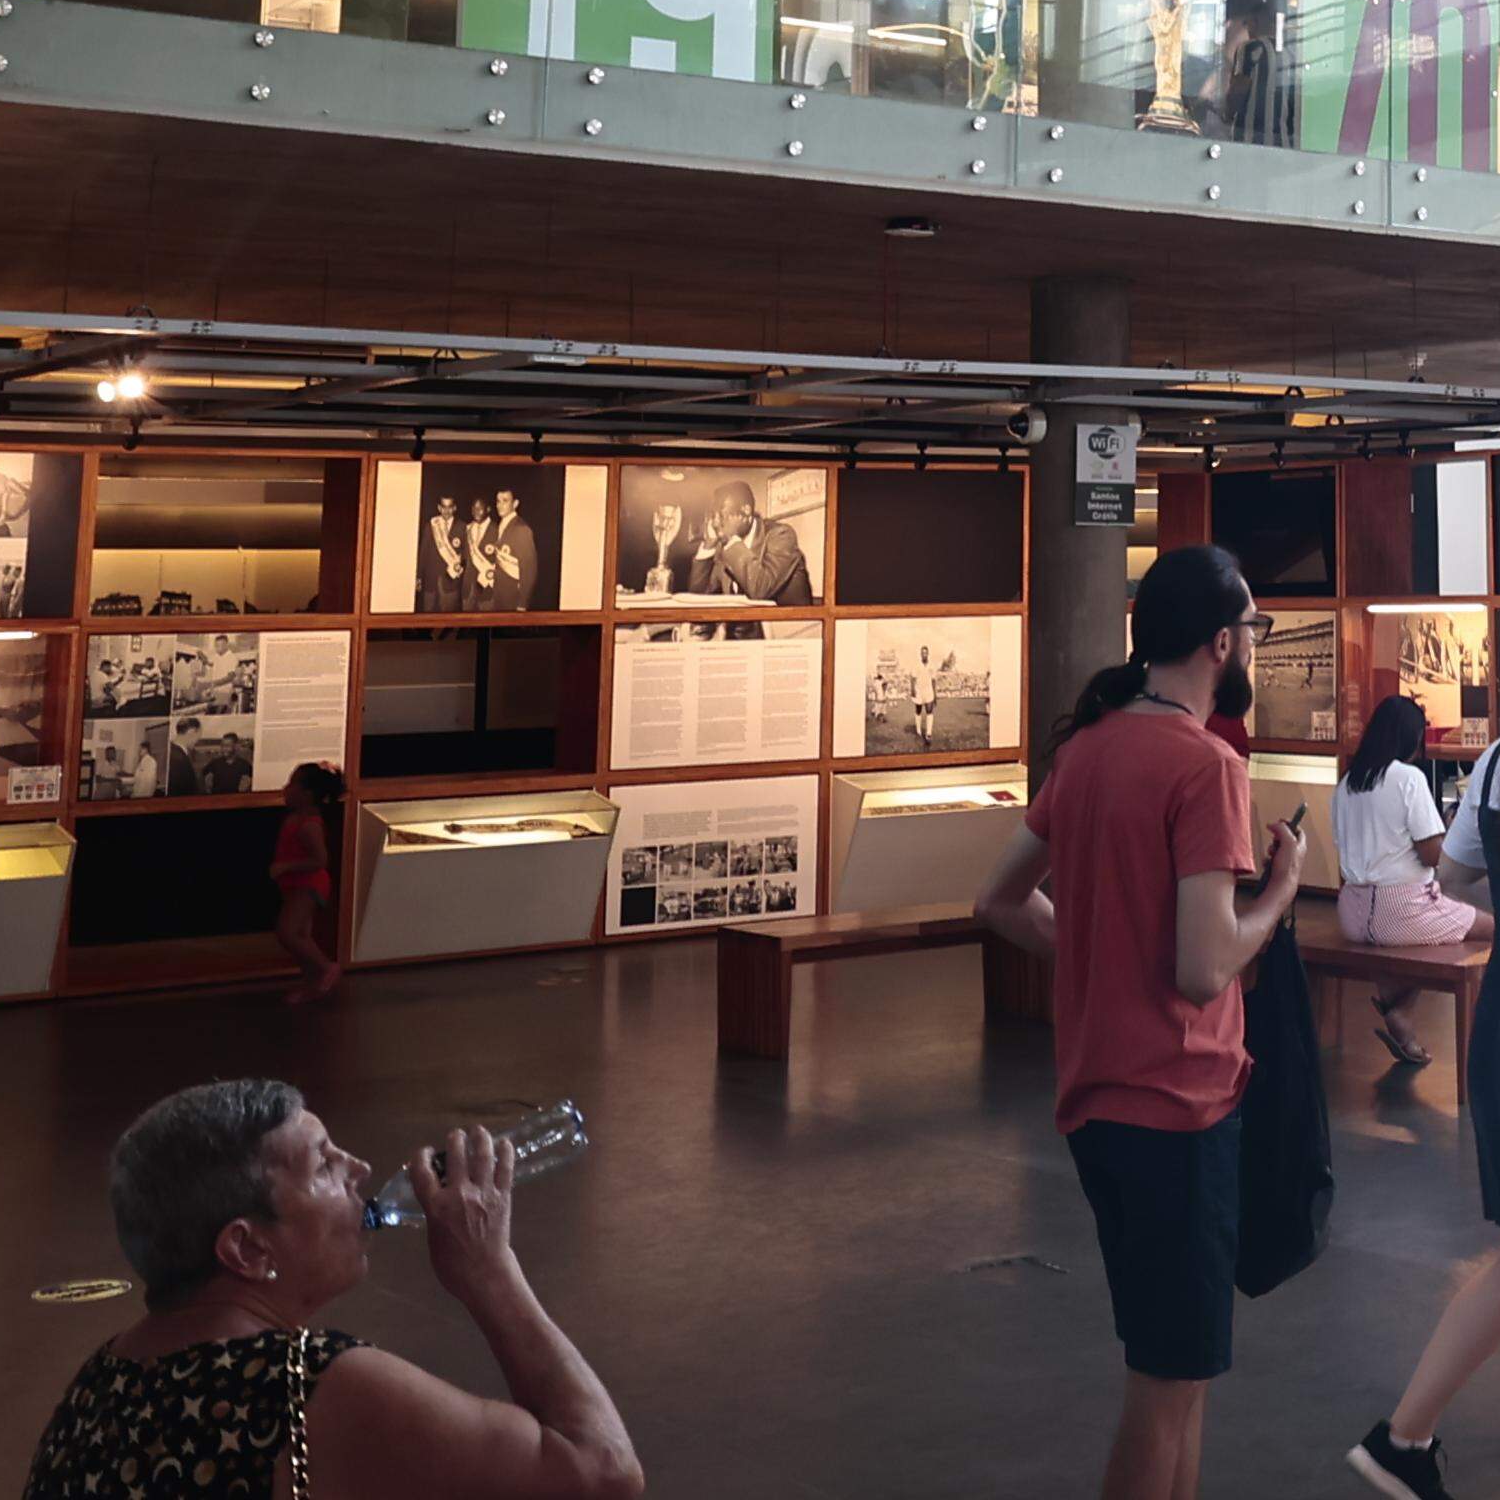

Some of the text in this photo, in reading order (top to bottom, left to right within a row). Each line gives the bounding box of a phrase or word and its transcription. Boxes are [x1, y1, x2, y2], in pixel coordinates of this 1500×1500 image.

[1091, 491, 1121, 501] Santos
[1087, 501, 1123, 511] Internet
[1092, 511, 1119, 521] Grátis
